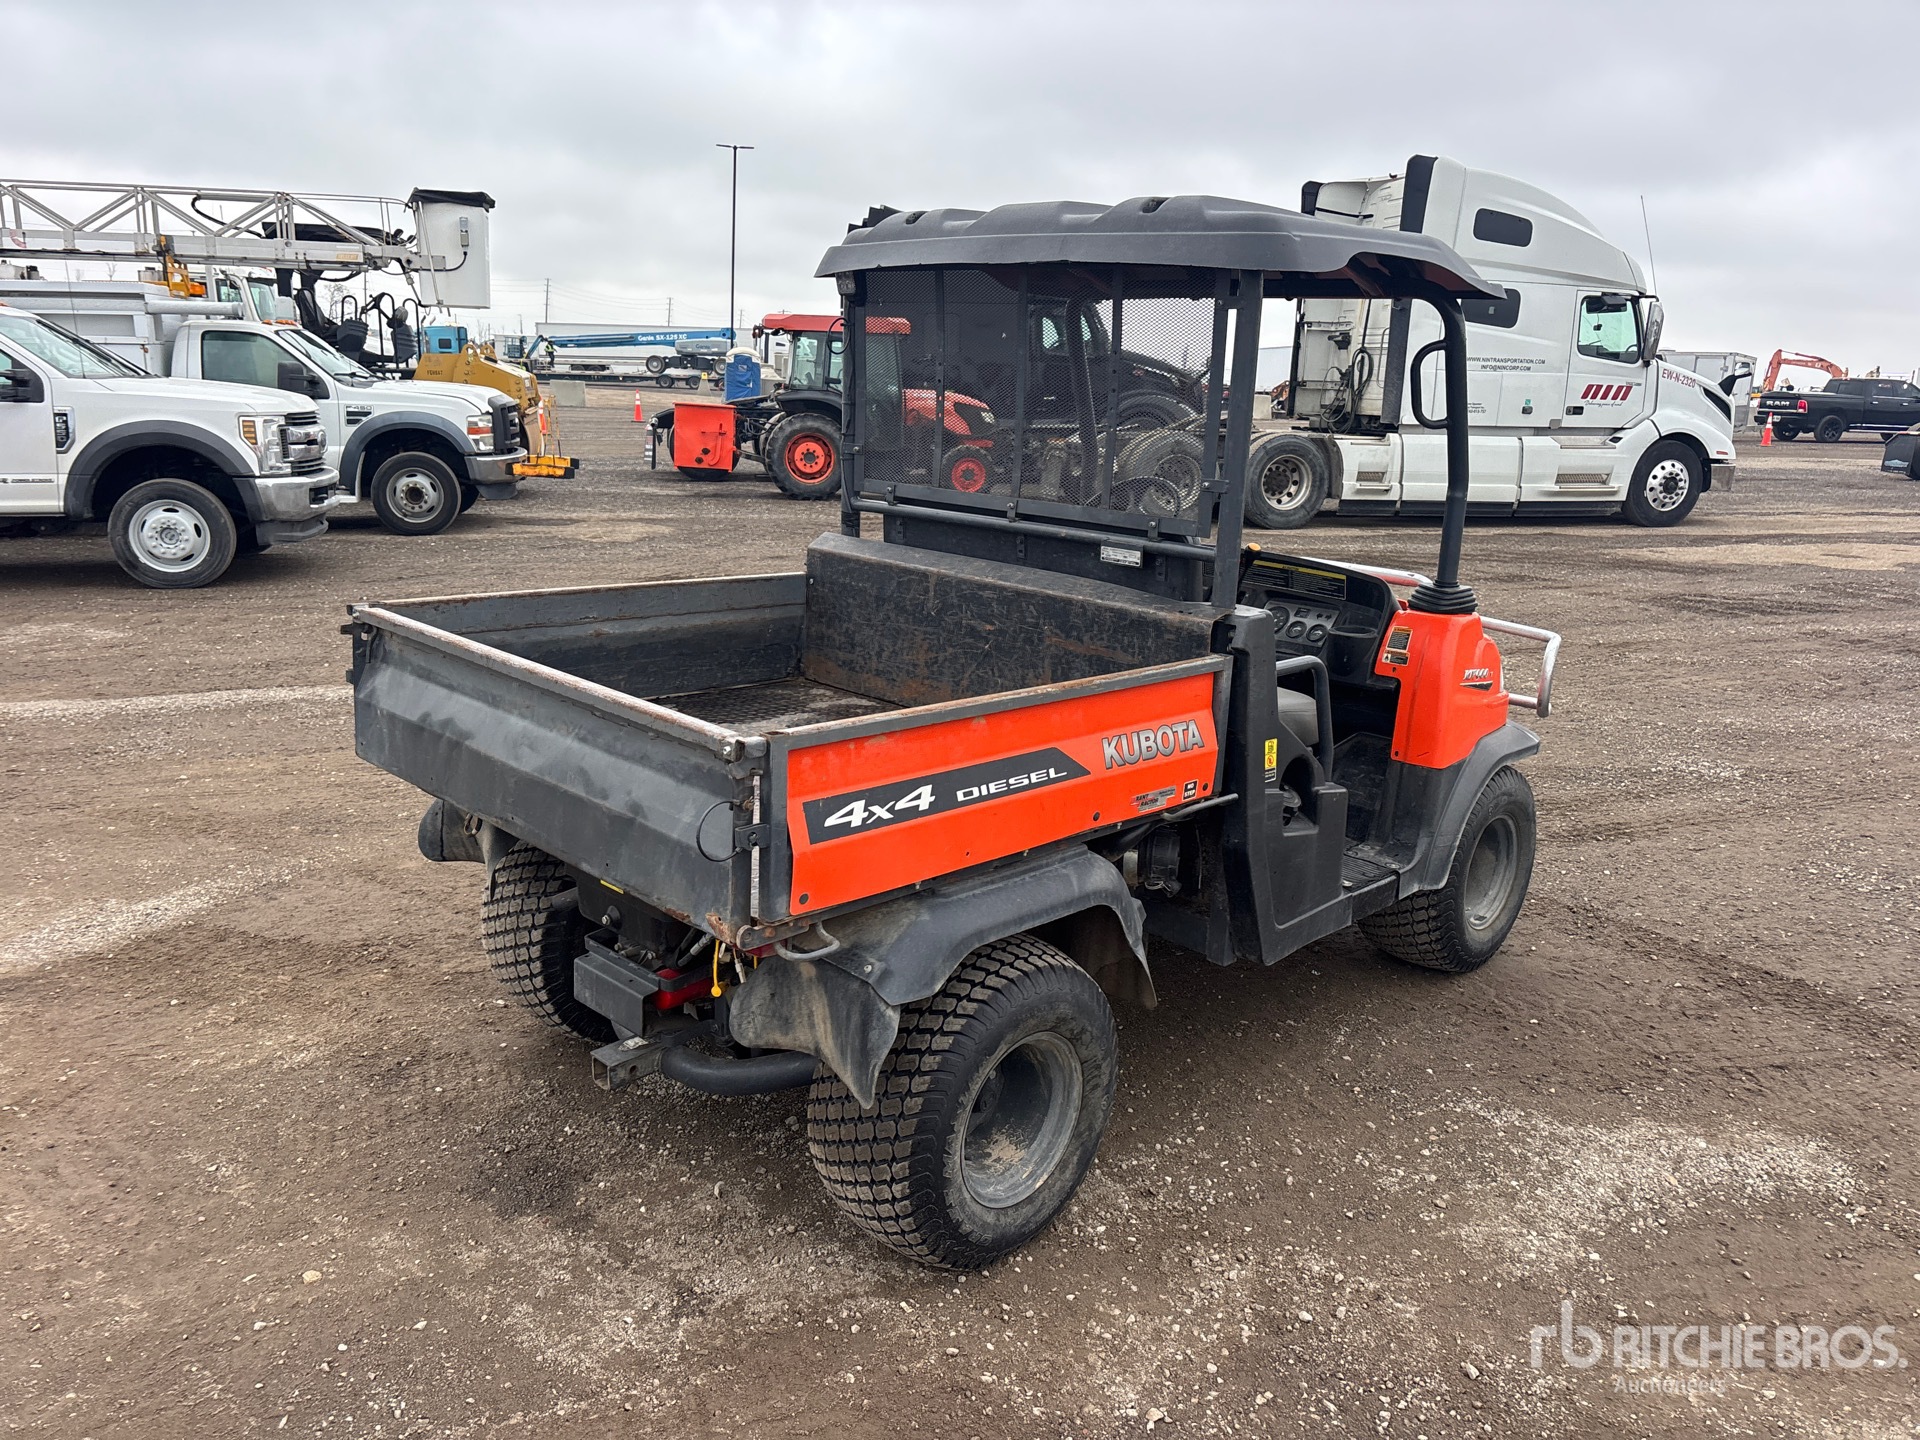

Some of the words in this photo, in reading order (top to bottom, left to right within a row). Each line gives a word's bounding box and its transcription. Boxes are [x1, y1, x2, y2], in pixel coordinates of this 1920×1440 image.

[1480, 364, 1532, 372] INFO@NINCORP.COM
[1661, 368, 1697, 389] EW-N-2320
[1101, 719, 1205, 770] KUBOTA
[1184, 789, 1196, 798] STEP
[1187, 782, 1195, 790] NO
[824, 784, 936, 828] 4x4
[956, 767, 1068, 802] DIESEL
